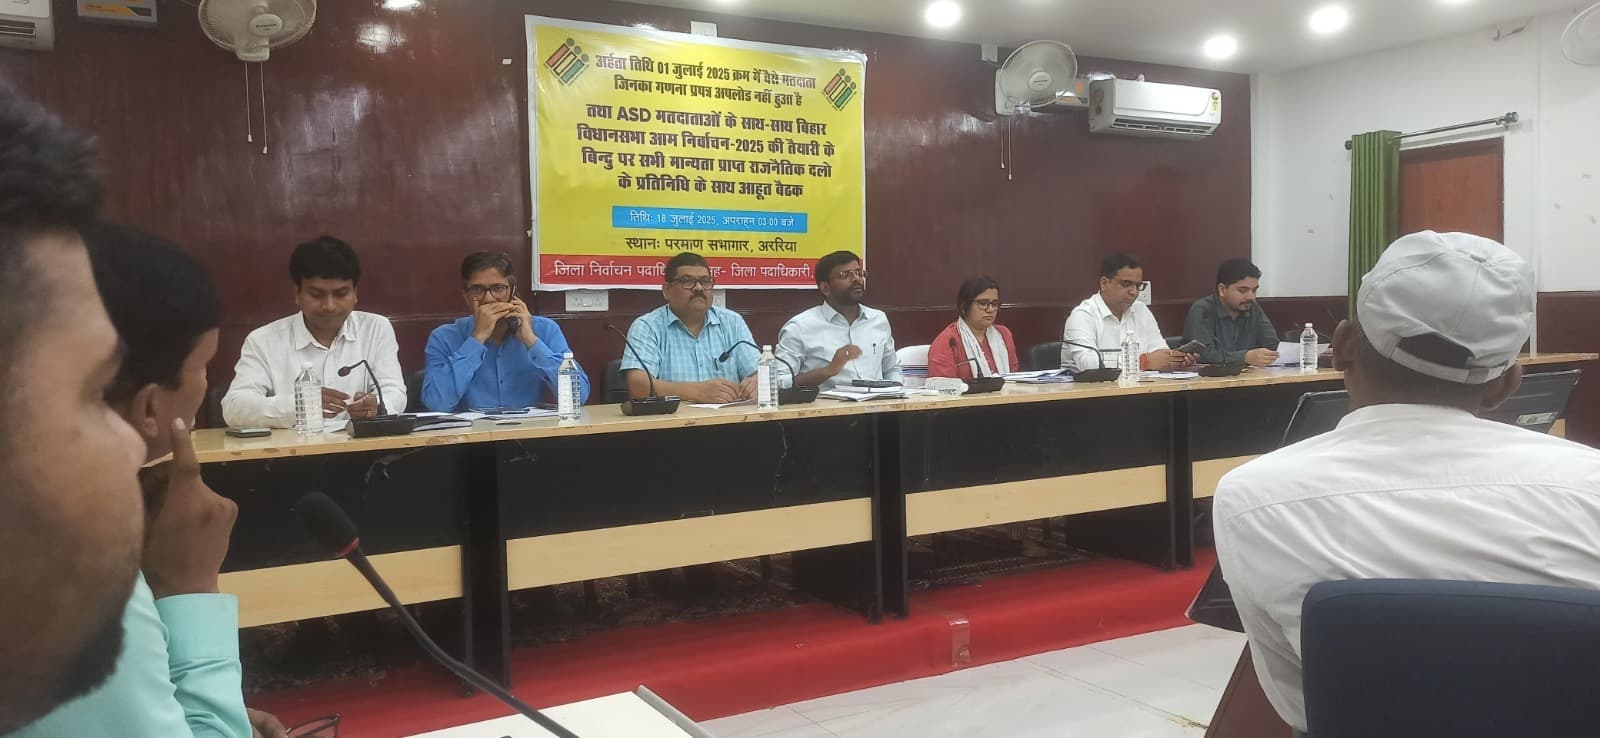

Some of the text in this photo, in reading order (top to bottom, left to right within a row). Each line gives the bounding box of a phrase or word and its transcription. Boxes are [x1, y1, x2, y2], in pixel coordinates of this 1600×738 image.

[630, 55, 654, 72] तिथि
[657, 61, 669, 74] 01
[672, 62, 703, 79] जुलाई
[706, 66, 729, 81] 2025
[732, 69, 749, 82] क्रम
[752, 67, 761, 84] में
[763, 70, 779, 85] वैसे
[614, 74, 803, 108] जिनका गणना प्रपत्र अपलोड नहीं हुआ है
[586, 103, 827, 135] तथा ASD मतदाताओं के साथ-साथ बिहार
[577, 122, 835, 157] विधानसभा आम निर्वाचन-2025 की तैयारी के
[581, 146, 832, 178] बिन्दु पर सभी मान्यता प्राप्त राजनैतिक दलो
[617, 171, 803, 200] के प्रतिनिधि के साथ आहूत बैठक
[657, 213, 666, 223] 18
[670, 211, 694, 227] जुलाई
[781, 216, 794, 227] बजे
[664, 238, 703, 250] परमाण
[708, 239, 754, 253] सभागार,
[758, 237, 797, 252] अररिया
[554, 259, 584, 276] जिला
[589, 260, 632, 277] निर्वाचन
[731, 262, 756, 278] जिला
[760, 263, 814, 279] पदाधिकारी,
